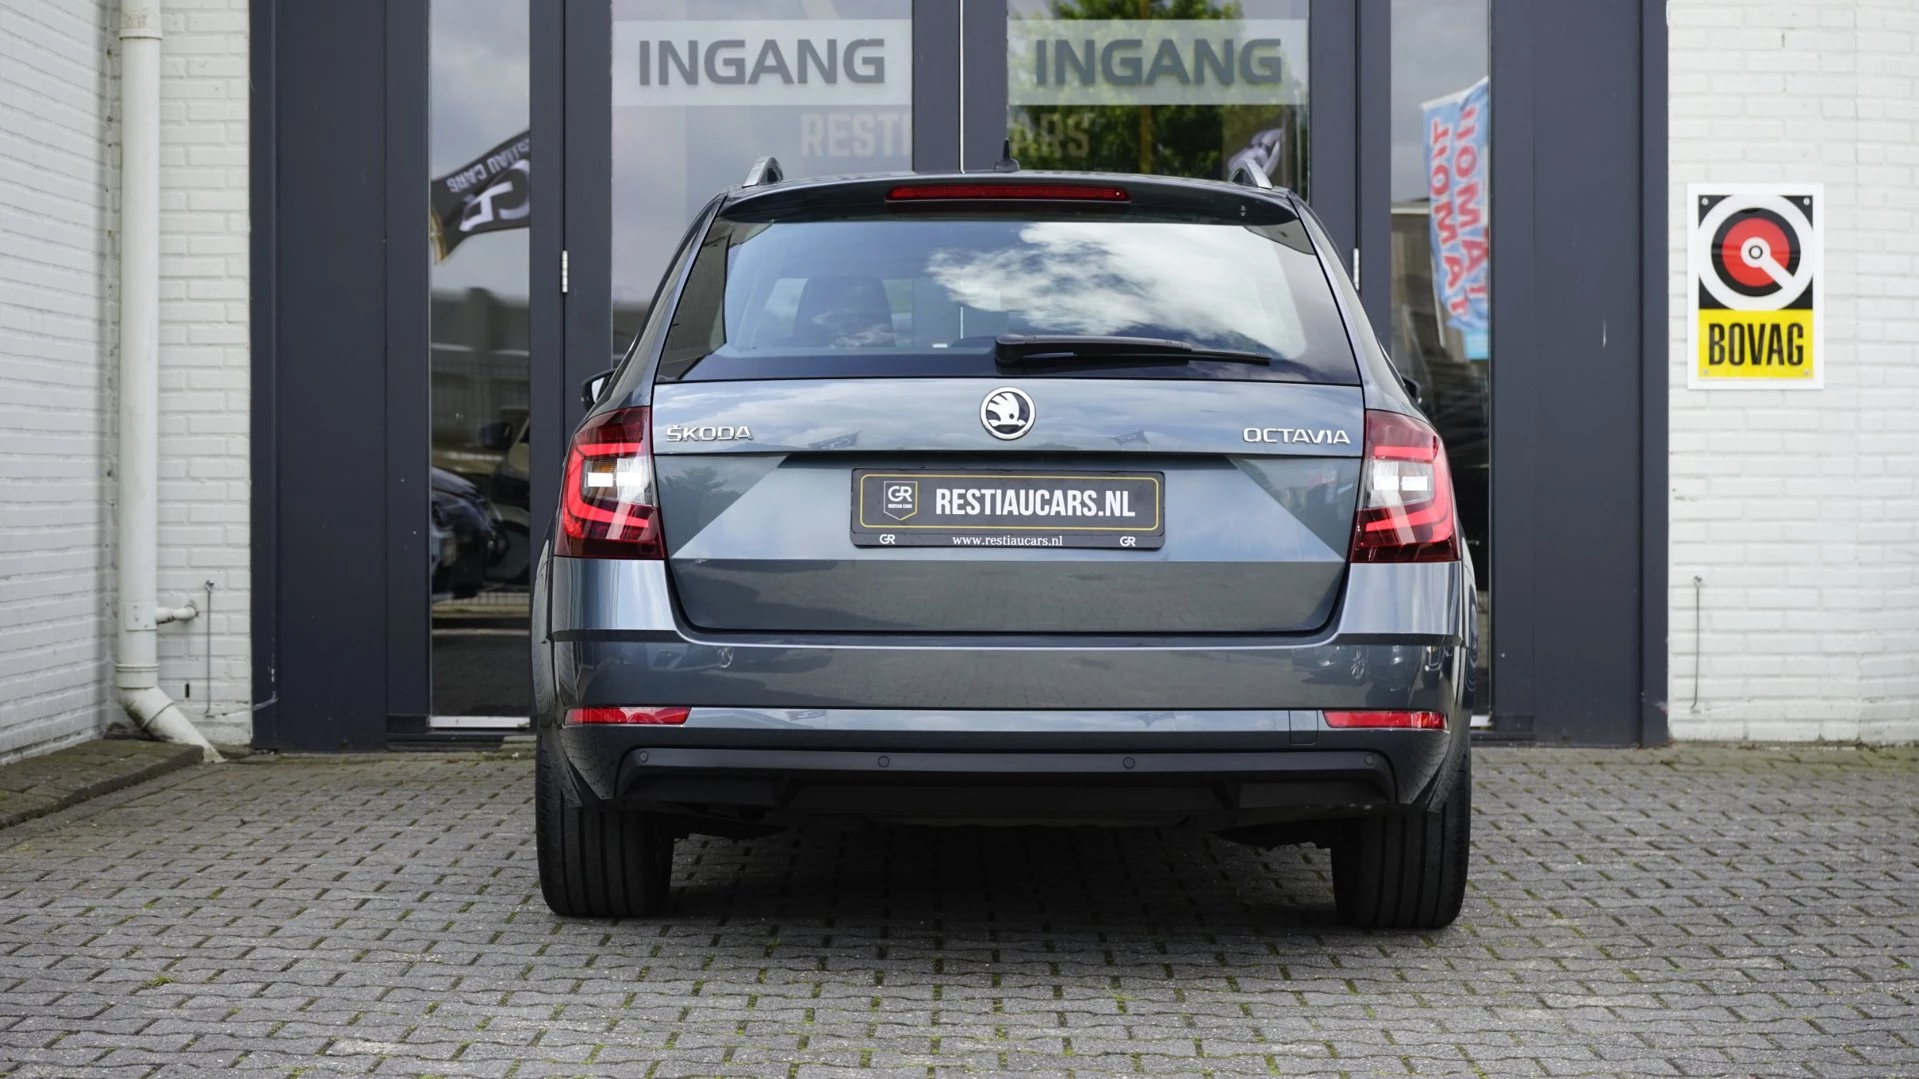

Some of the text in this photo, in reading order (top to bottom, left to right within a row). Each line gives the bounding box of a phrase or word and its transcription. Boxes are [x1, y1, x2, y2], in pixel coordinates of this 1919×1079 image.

[639, 39, 885, 86] INGANG
[1036, 38, 1282, 86] INGANG
[1708, 322, 1804, 367] BOVAG
[666, 425, 753, 441] ŠKODA
[1243, 427, 1351, 444] OCTAVIA
[935, 488, 1136, 517] RESTIAUCARS.NL
[952, 535, 1063, 547] www.restiaucars.nl
